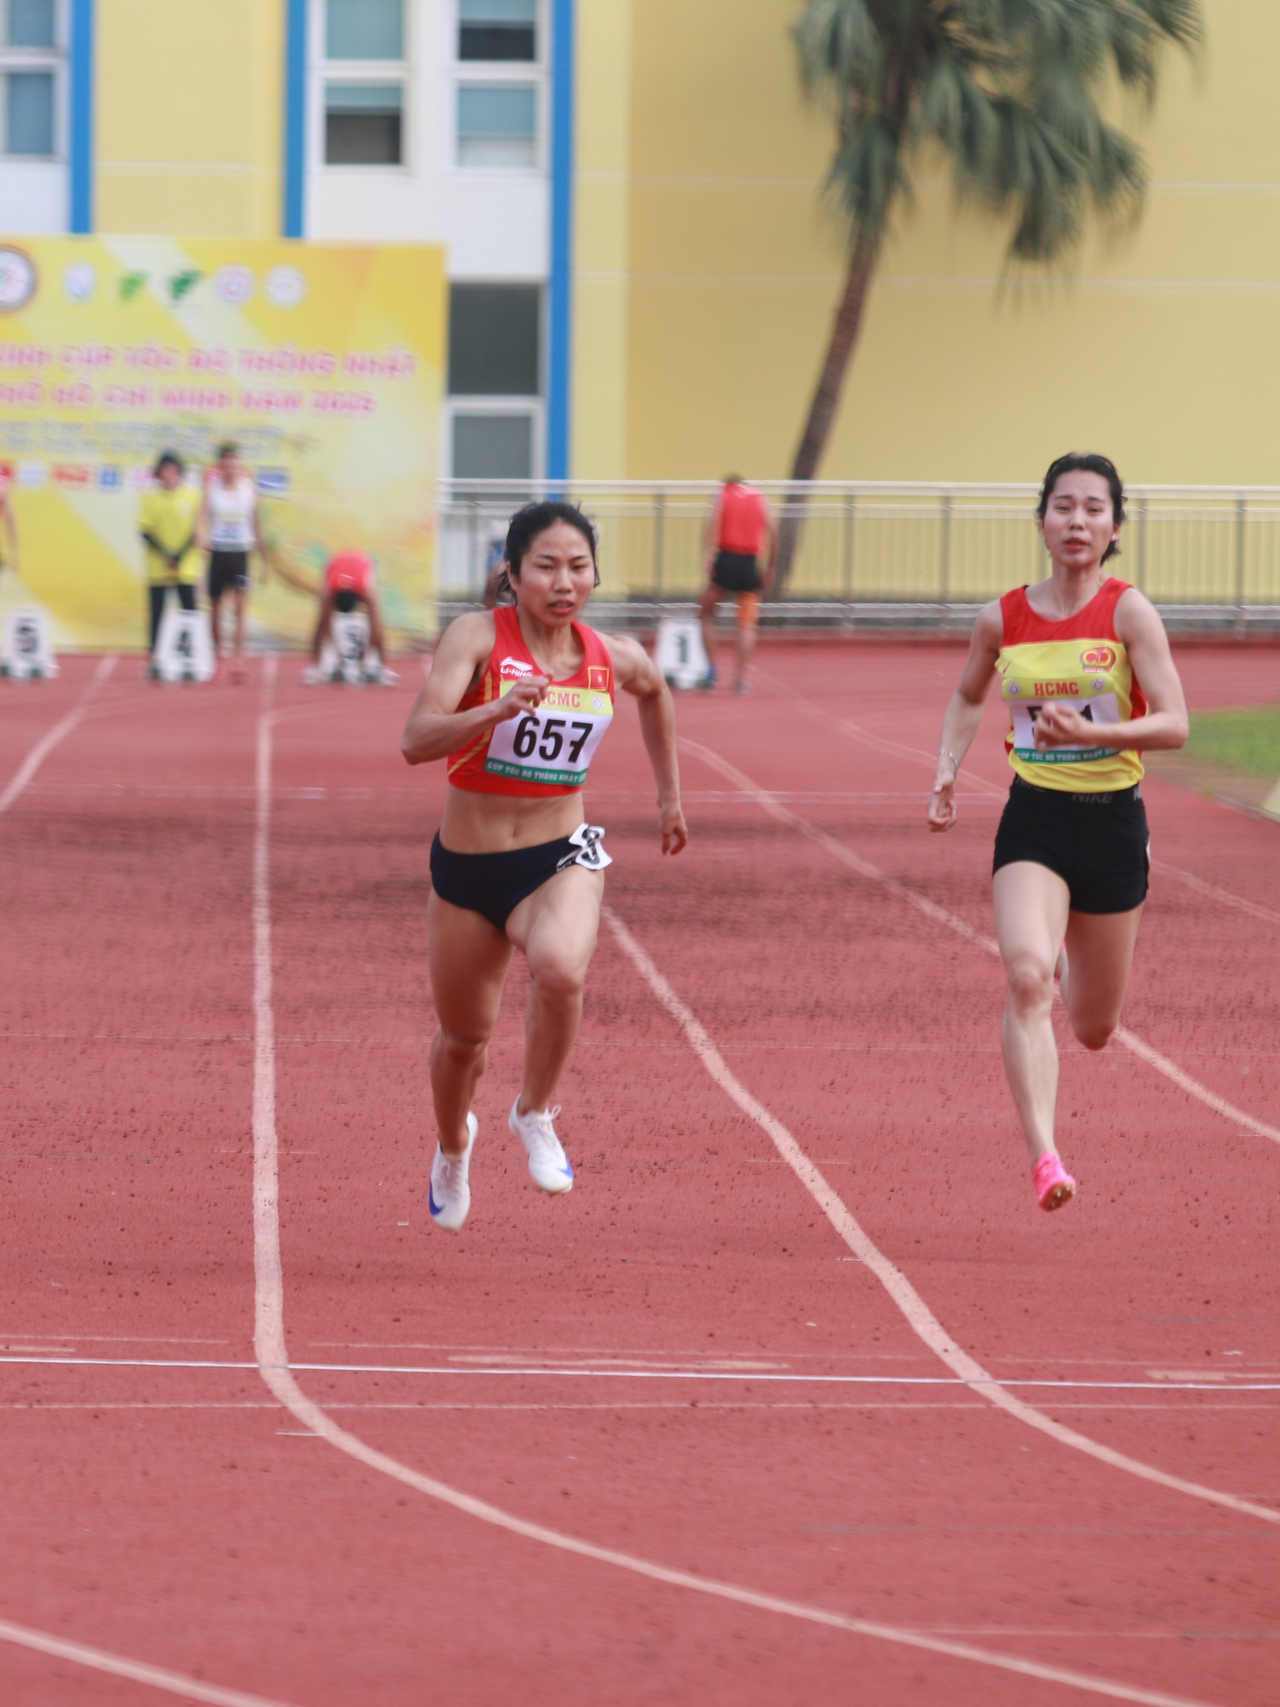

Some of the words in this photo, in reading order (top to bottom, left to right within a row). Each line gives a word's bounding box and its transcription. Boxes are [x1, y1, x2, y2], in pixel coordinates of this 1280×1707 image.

[1034, 682, 1079, 697] HCMC
[541, 690, 581, 709] CMC
[513, 716, 593, 763] 657
